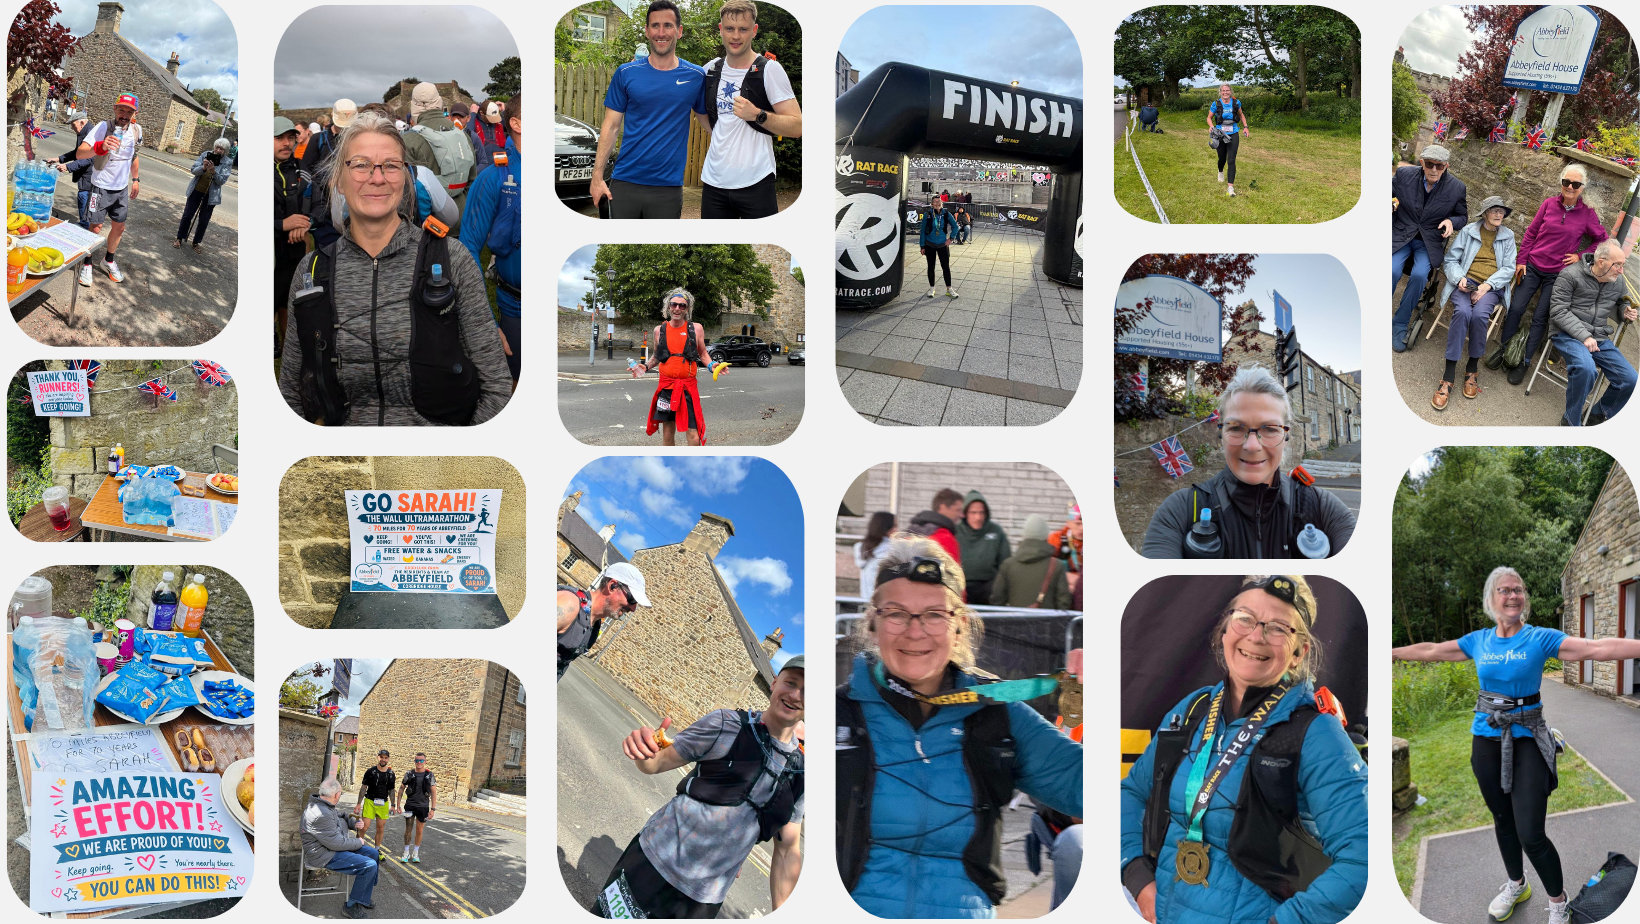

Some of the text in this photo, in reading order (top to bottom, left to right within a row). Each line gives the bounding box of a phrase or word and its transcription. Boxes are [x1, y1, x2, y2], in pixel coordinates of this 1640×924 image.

[1510, 60, 1579, 73] Abbeyfield House
[717, 101, 734, 110] AYS
[943, 79, 1074, 138] FINISH
[563, 169, 593, 179] RF25 HH
[856, 161, 898, 175] RAT RACE
[1152, 295, 1192, 309] Abbeyfield
[1119, 335, 1151, 343] Supported
[1152, 339, 1175, 348] Housing
[1129, 326, 1215, 344] bbeyfield House
[1115, 345, 1169, 355] ww.abbeyfield.com
[34, 371, 79, 383] THANK YOU,
[38, 381, 80, 393] RUNNERS!
[42, 402, 81, 411] KEEP GOING!
[362, 492, 476, 512] GO SARAH!
[366, 514, 470, 523] THE WALL ULTRAMARATHON
[391, 574, 454, 583] ABBEYFIELD
[1481, 649, 1527, 664] Abbeyfield
[1204, 781, 1213, 793] RAT
[1210, 769, 1221, 783] RACE
[1218, 730, 1251, 767] THE
[1249, 683, 1291, 722] WALL
[65, 742, 138, 758] FOR 70 YEARS
[95, 752, 151, 773] SARAH
[72, 775, 196, 805] AMAZING
[72, 800, 205, 838] EFFORT!
[82, 835, 212, 856] WE ARE PROUD OF YOU!
[67, 863, 114, 877] Keep going.
[175, 857, 236, 869] You're nearly there.
[90, 875, 220, 898] YOU CAN DO THIS!
